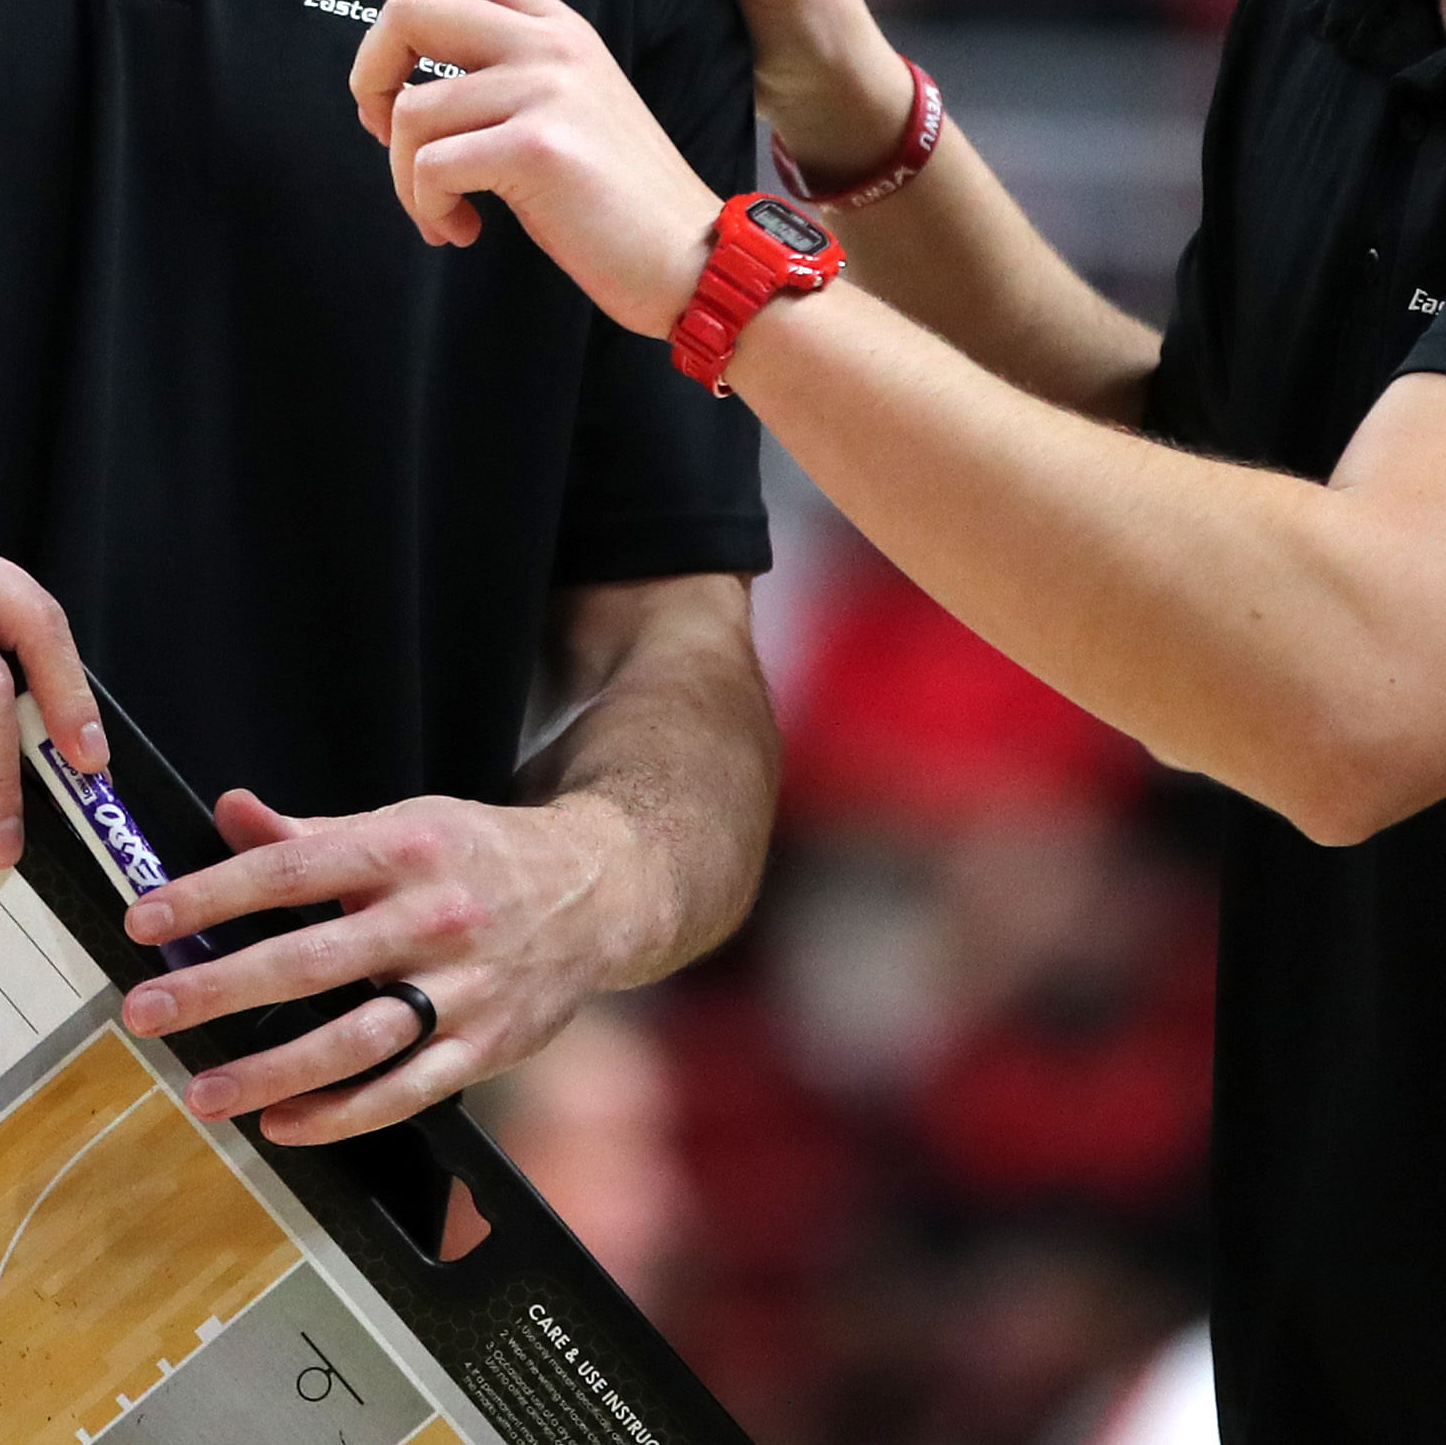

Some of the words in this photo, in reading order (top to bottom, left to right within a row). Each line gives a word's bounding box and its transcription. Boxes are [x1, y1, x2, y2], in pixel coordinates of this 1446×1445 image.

[95, 803, 170, 886] EXPO
[529, 1304, 570, 1349] CARE
[564, 1346, 581, 1363] &
[576, 1360, 607, 1393] USE
